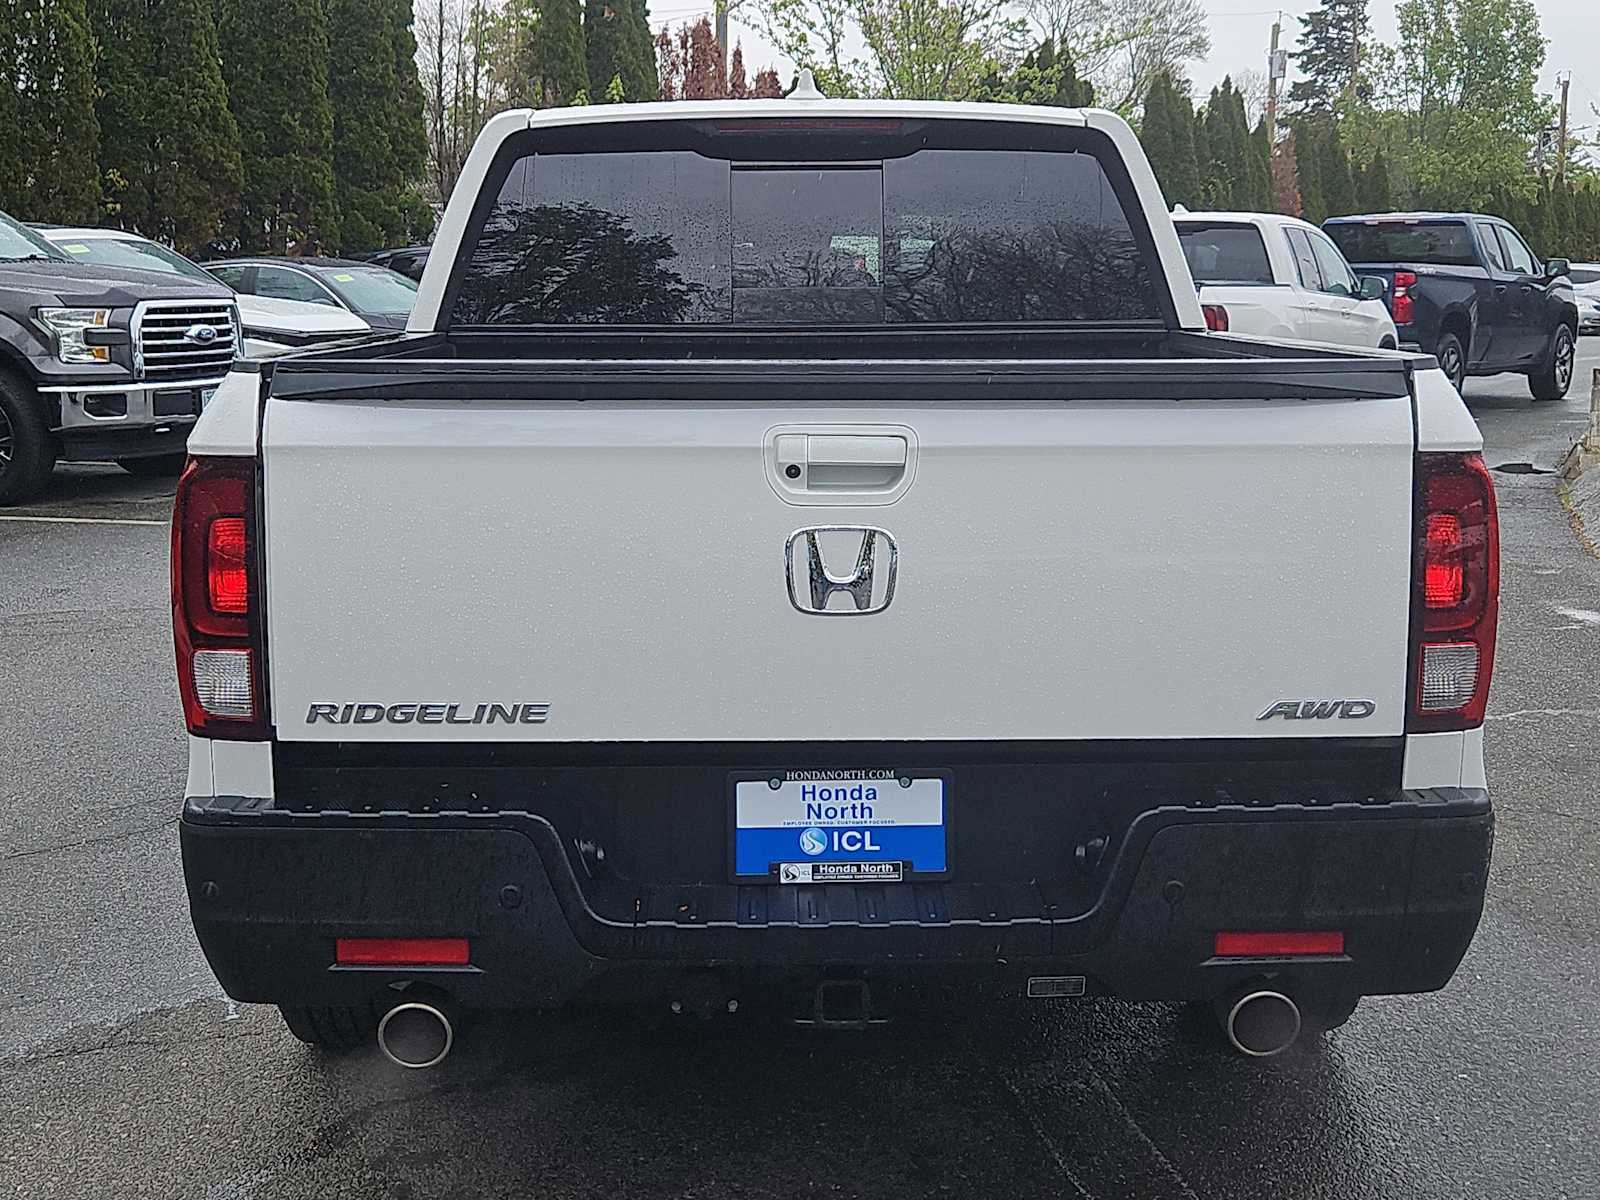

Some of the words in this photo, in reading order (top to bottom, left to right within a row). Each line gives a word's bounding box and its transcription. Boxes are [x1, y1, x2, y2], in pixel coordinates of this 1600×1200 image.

[306, 702, 551, 724] RIDGELINE
[1256, 699, 1376, 720] AWD
[786, 770, 895, 780] HONDANORTH.COM
[802, 784, 877, 801] Honda
[807, 803, 873, 819] North
[833, 831, 880, 851] ICL
[820, 864, 858, 873] Honda
[861, 863, 894, 873] North
